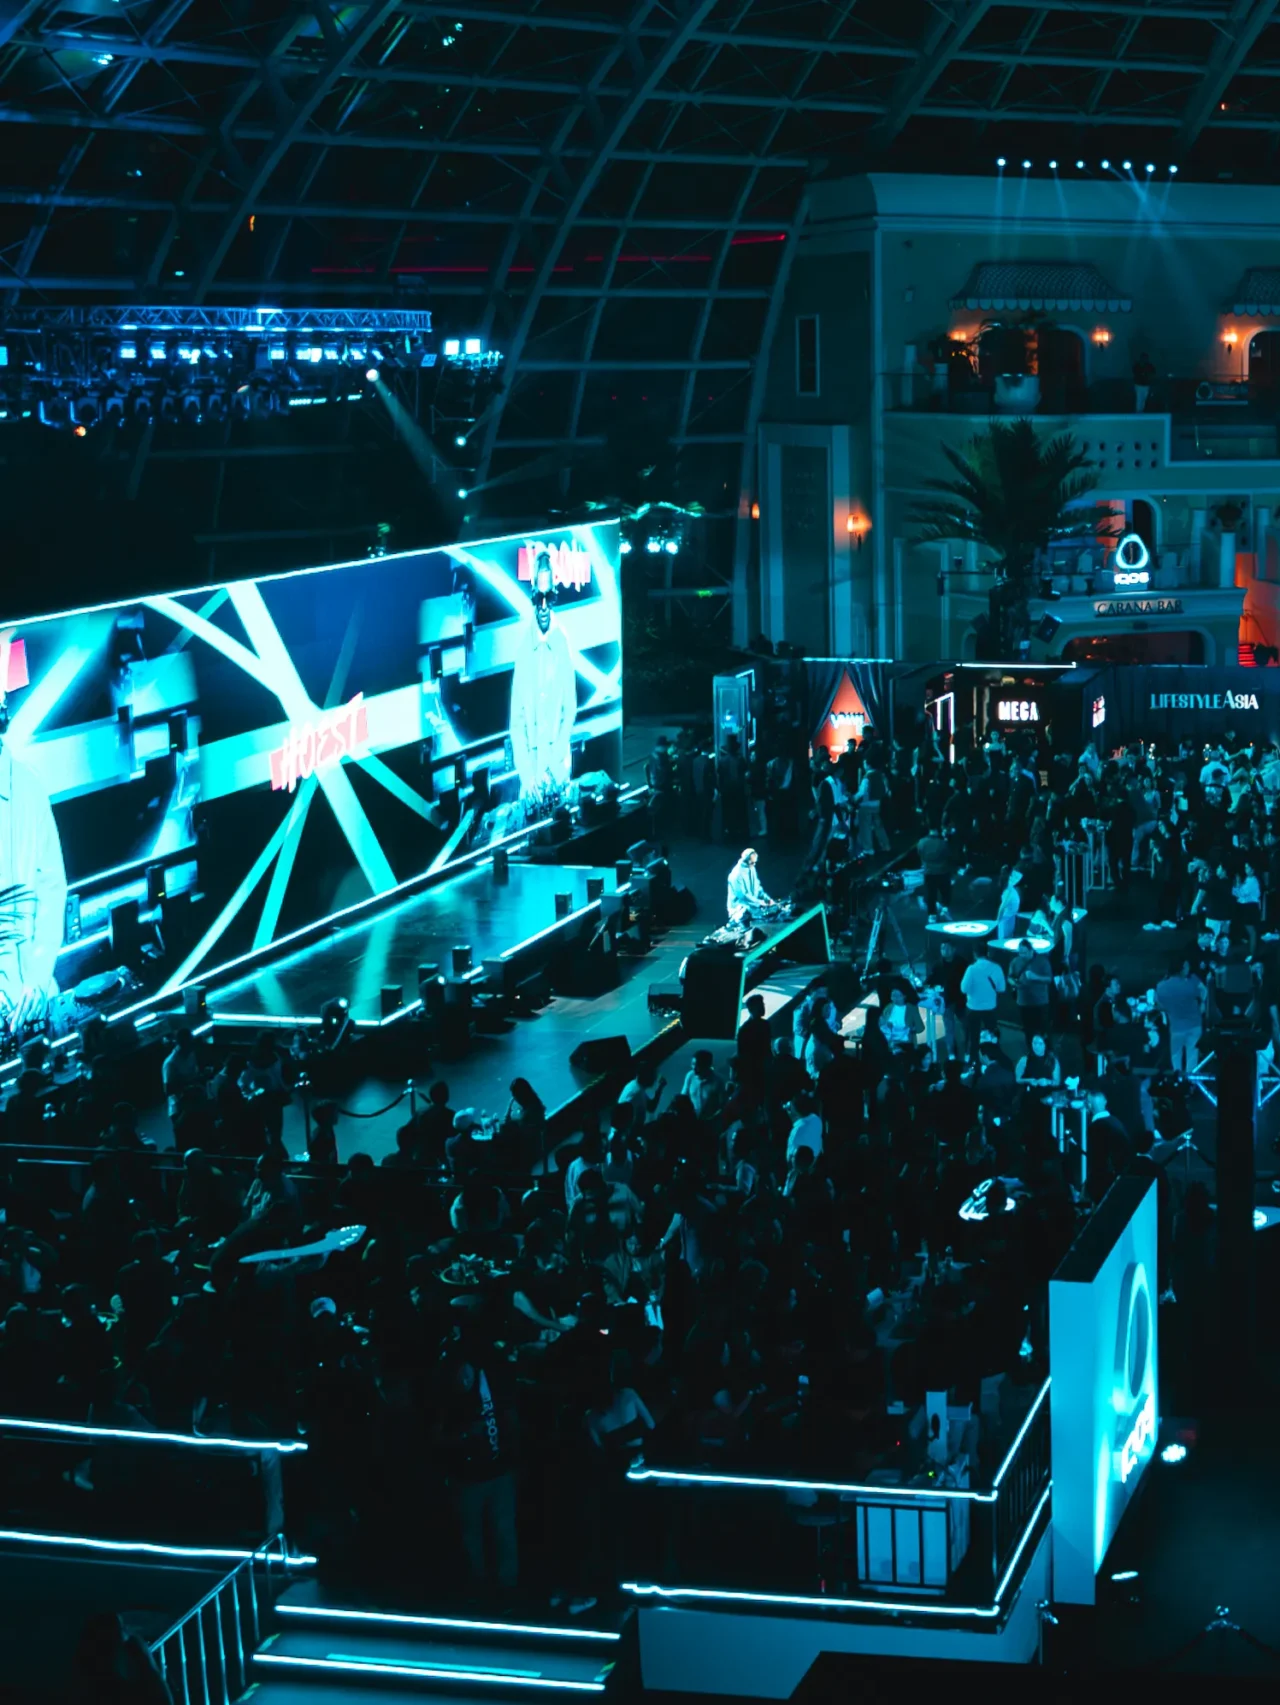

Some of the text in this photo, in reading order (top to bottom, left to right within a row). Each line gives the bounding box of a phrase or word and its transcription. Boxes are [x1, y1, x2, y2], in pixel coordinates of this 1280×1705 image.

[1097, 600, 1183, 615] CABANA BAR
[998, 701, 1039, 721] MEGA
